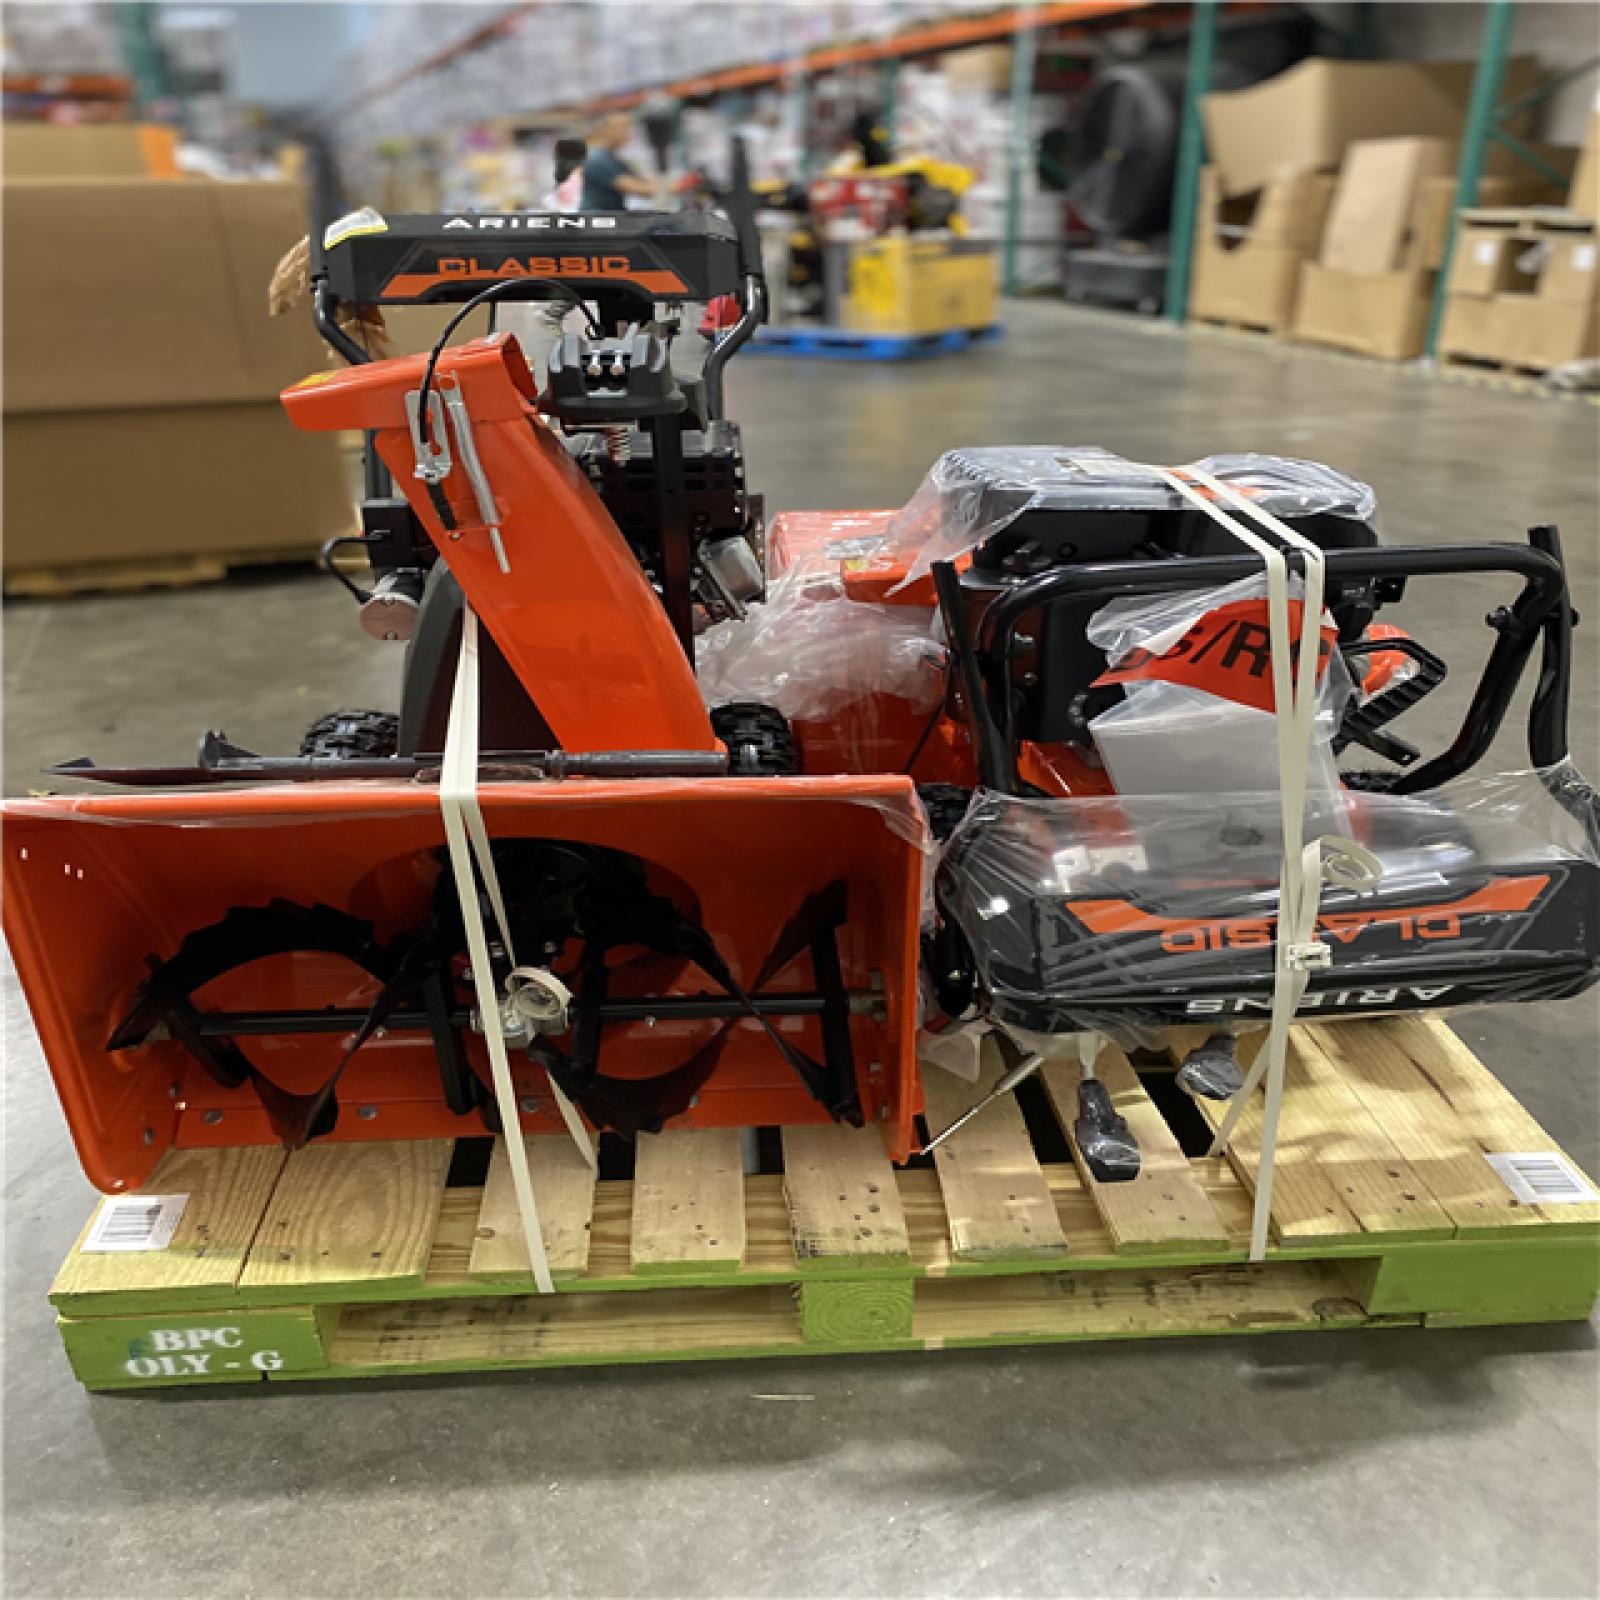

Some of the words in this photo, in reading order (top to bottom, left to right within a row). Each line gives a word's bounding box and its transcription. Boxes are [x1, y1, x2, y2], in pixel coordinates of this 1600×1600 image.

[442, 216, 617, 230] ARIENS
[437, 256, 630, 276] CLASSIC
[1161, 911, 1461, 953] CLASIC
[151, 1326, 243, 1352] BPC
[125, 1353, 211, 1377] OLY
[252, 1350, 284, 1371] G
